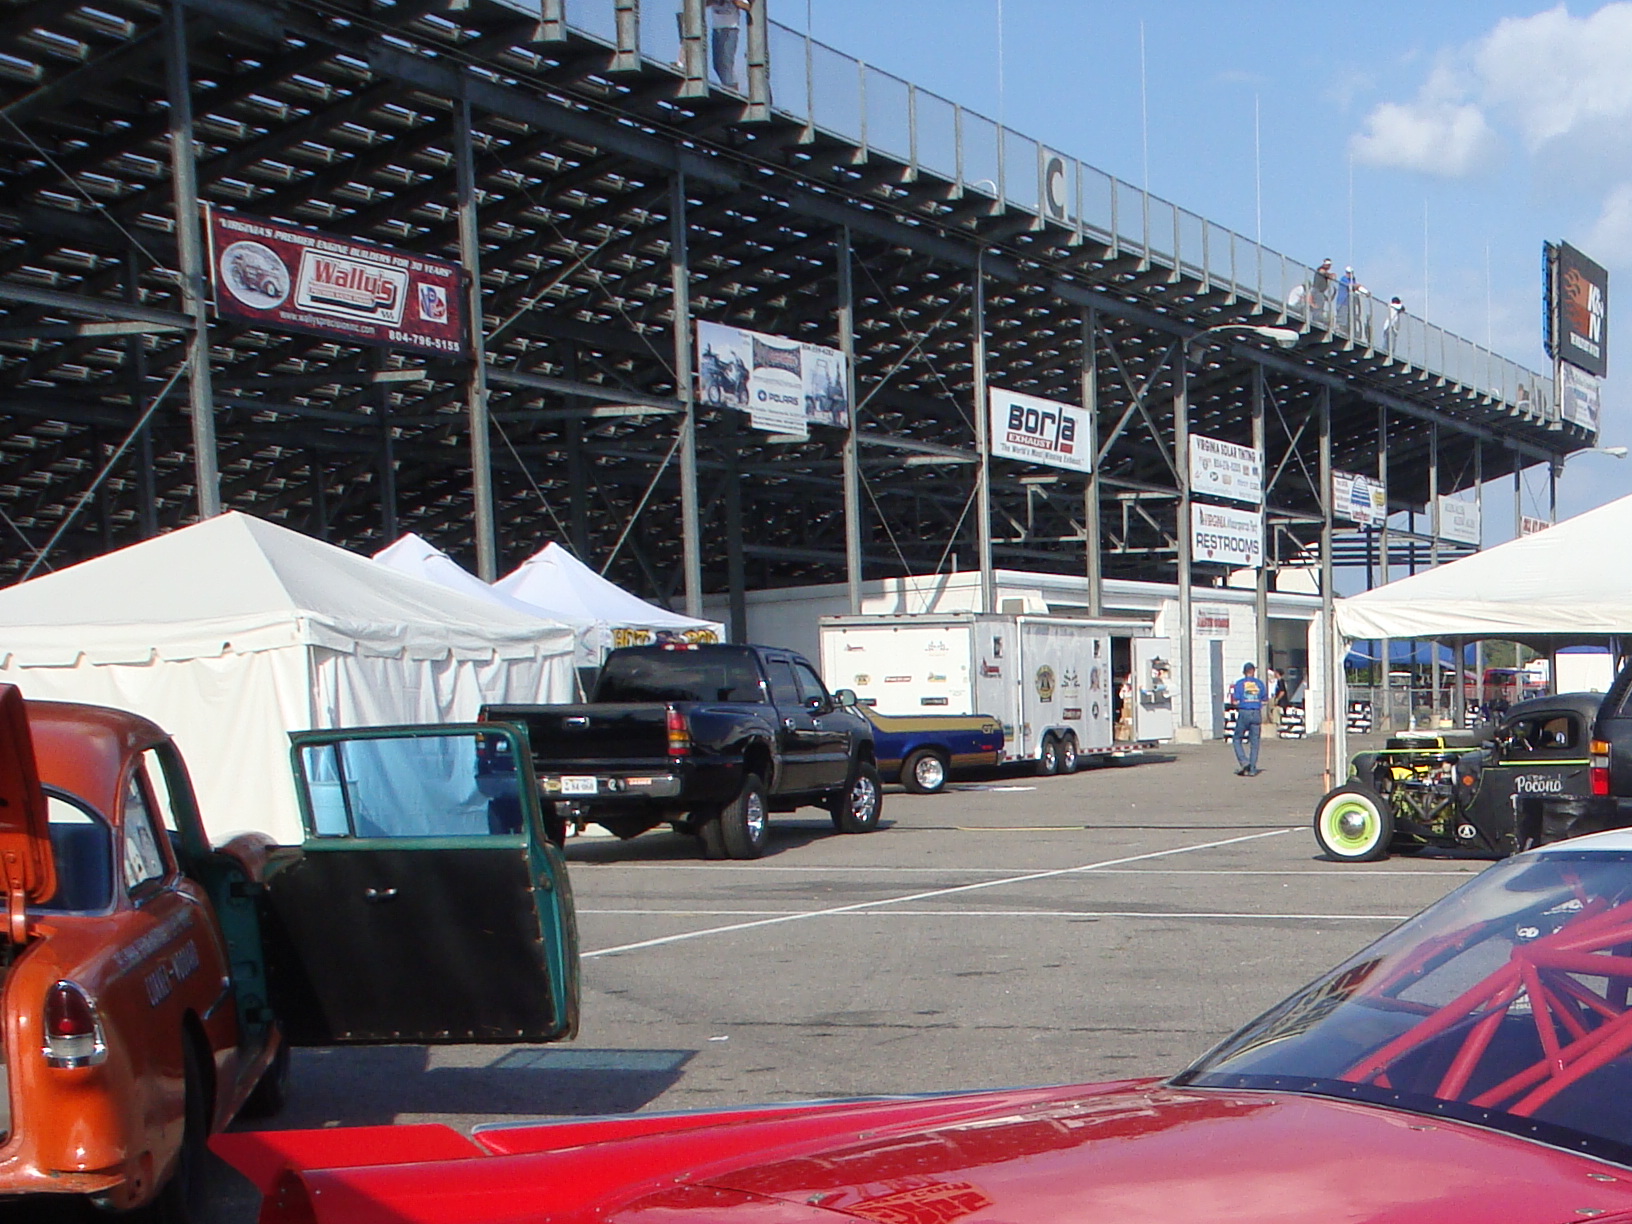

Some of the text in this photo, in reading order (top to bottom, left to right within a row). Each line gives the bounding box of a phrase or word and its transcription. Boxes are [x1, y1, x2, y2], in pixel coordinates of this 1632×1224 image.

[314, 259, 394, 300] Wally's
[1008, 434, 1052, 449] EXHAUST
[1196, 532, 1259, 555] RESTROOMS
[1514, 775, 1562, 793] Pocono
